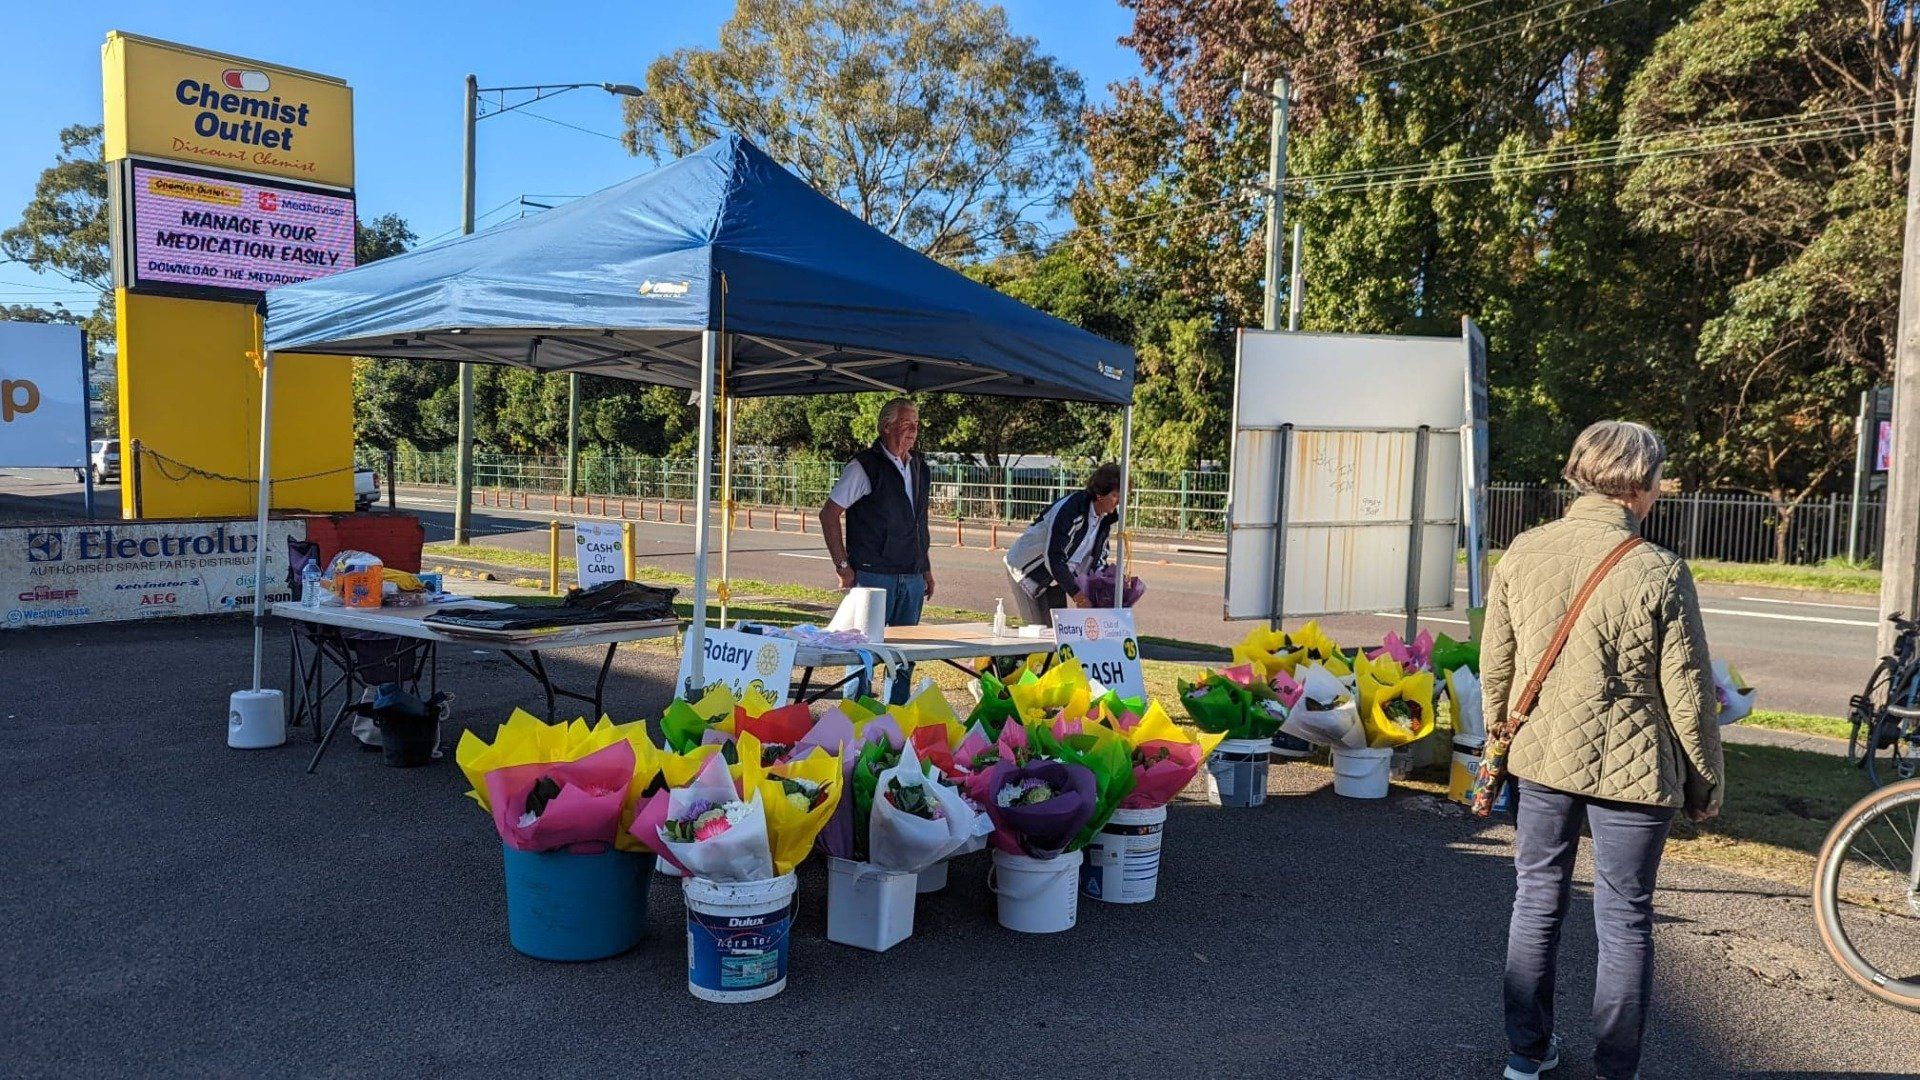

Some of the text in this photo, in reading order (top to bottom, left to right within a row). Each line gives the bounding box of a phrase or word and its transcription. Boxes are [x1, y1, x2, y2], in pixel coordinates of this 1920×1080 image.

[176, 79, 310, 126] Chemist
[194, 111, 294, 151] Outlet
[172, 136, 316, 172] Discount Chemist
[281, 199, 345, 217] MedAdvisor
[181, 210, 318, 243] MANAGE YOUR
[156, 230, 340, 267] MEDICATION EASILY
[148, 260, 219, 277] DOWNLOAD
[223, 268, 244, 280] THE
[586, 542, 613, 553] CASH
[29, 555, 273, 577] AUTHORISED SPARE PARTS DISTRIBUTR
[587, 564, 615, 574] CARD
[140, 592, 176, 606] AEG
[23, 606, 90, 621] Westinghouse
[1058, 623, 1083, 636] Rotary
[704, 637, 753, 671] Rotary
[729, 917, 764, 927] Dulux
